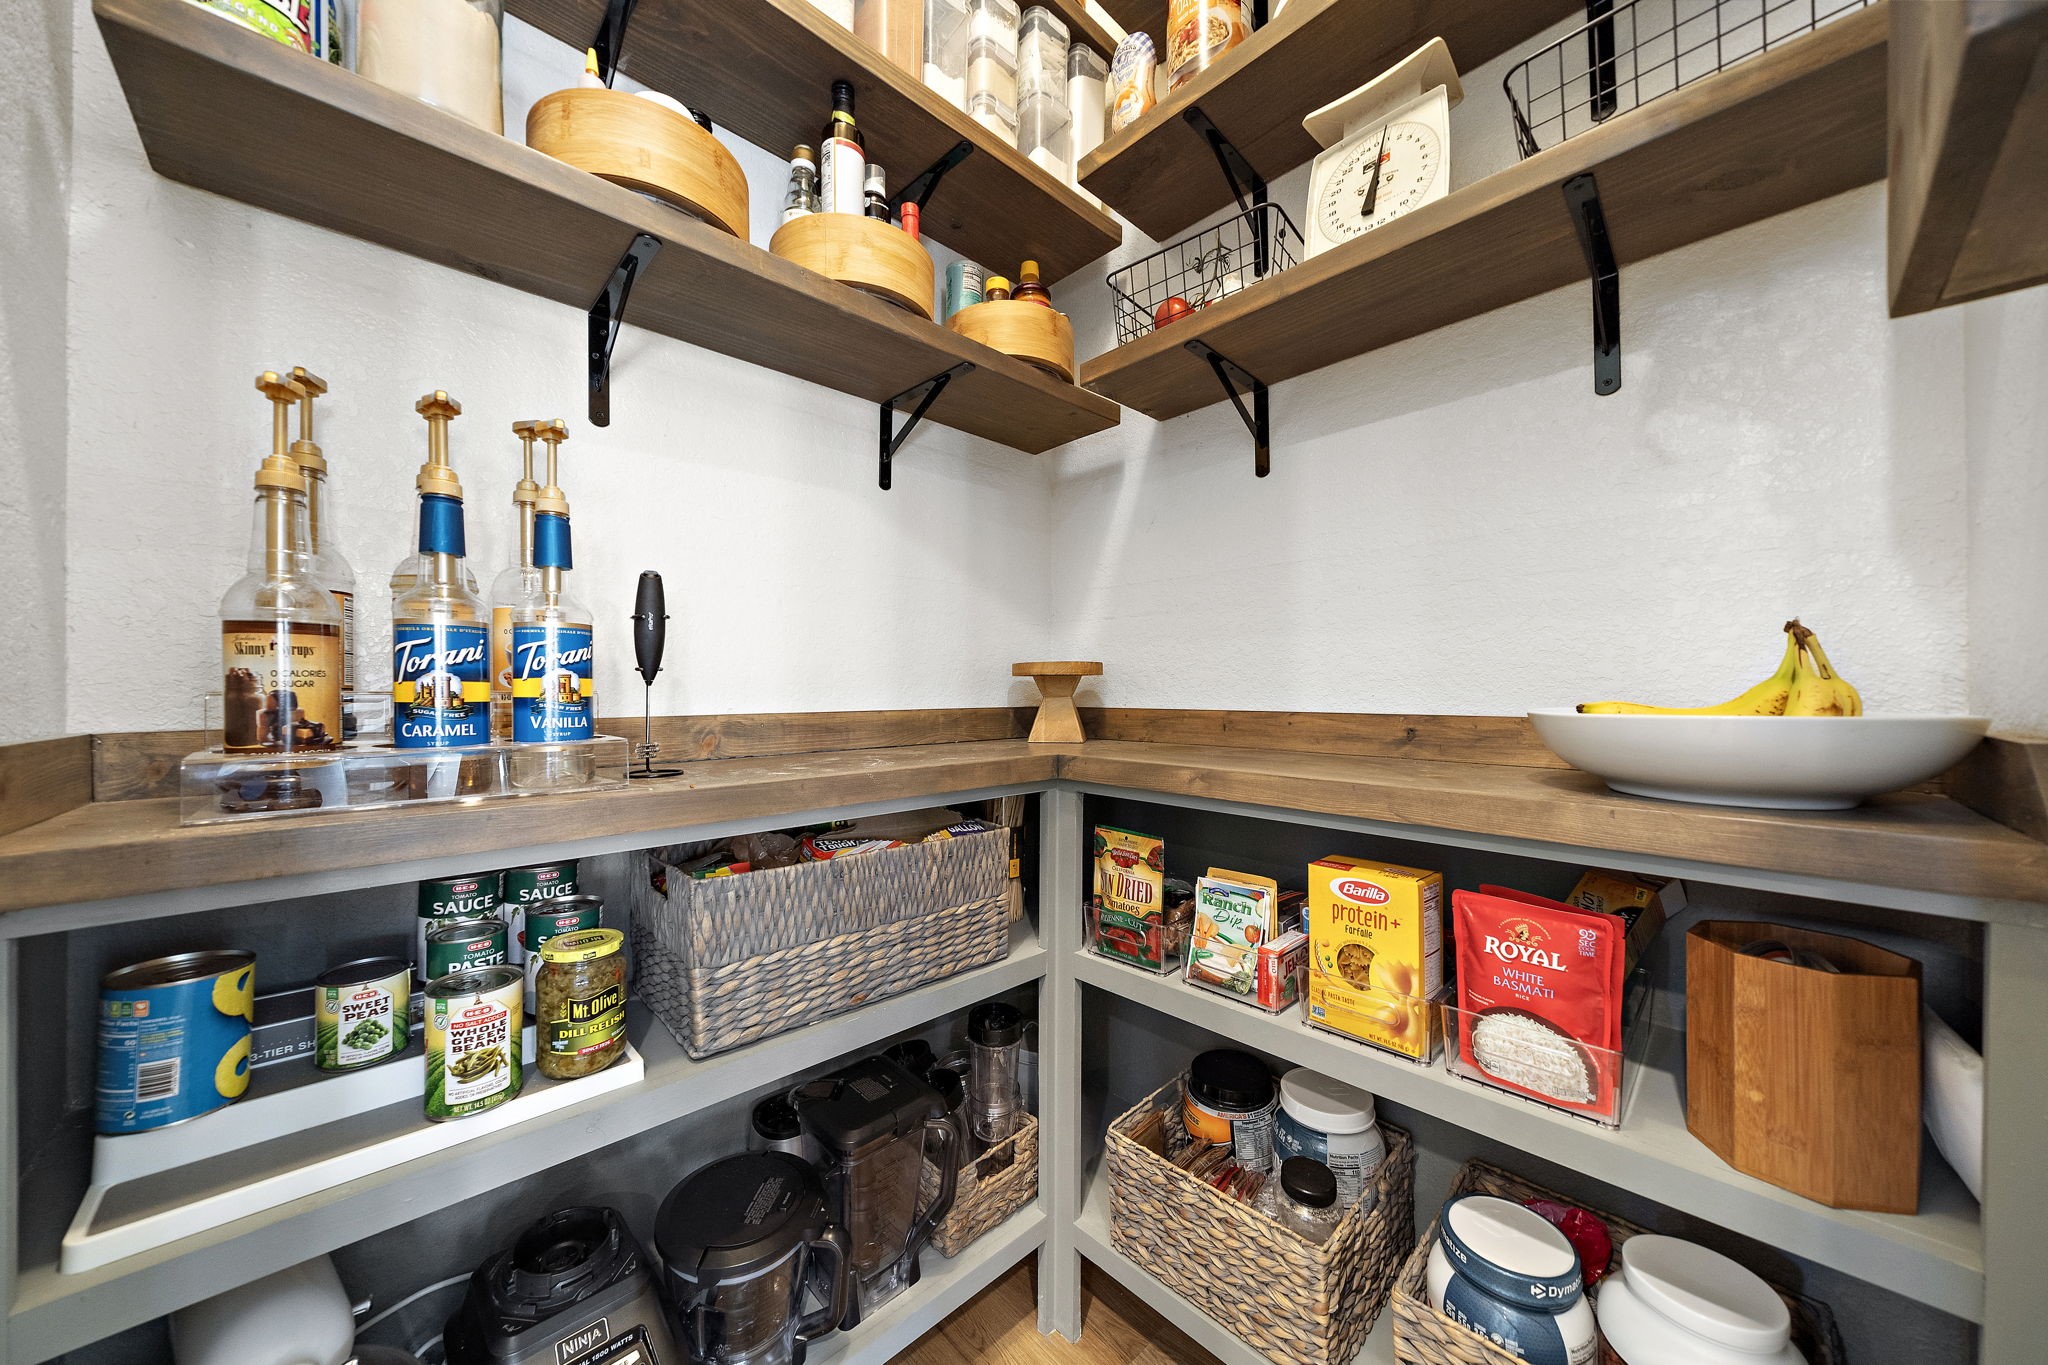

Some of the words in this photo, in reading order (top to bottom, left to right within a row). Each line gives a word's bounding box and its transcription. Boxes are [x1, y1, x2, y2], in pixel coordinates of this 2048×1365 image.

[234, 641, 267, 658] Skinny
[395, 637, 485, 685] Torani
[518, 640, 593, 682] Torani
[283, 669, 327, 678] CALORIES
[282, 680, 315, 688] SUGAR
[443, 710, 466, 718] FREE
[530, 716, 588, 729] VANILLA
[402, 723, 477, 737] CARAMEL
[947, 823, 985, 833] GALLON
[819, 840, 856, 851] TOUGH
[519, 882, 573, 901] SAUCE
[536, 879, 559, 887] TOMATO
[1116, 872, 1153, 904] DRIED
[1343, 883, 1386, 901] Barilla
[433, 894, 494, 915] SAUCE
[451, 892, 477, 900] TOMATO
[1202, 893, 1252, 916] Ranch
[1213, 908, 1243, 928] Dip
[1332, 903, 1388, 931] protein
[554, 926, 579, 934] TOMATO
[1578, 939, 1596, 947] SEC
[448, 951, 504, 974] PASTE
[464, 948, 495, 960] TOMATO
[1484, 935, 1567, 972] ROYAL
[1502, 966, 1544, 986] WHITE
[1494, 975, 1554, 999] BASMATI
[342, 996, 390, 1013] SWEET
[573, 1003, 591, 1019] Mt.
[591, 992, 618, 1015] Olive
[1515, 993, 1530, 1001] RICE
[344, 1005, 389, 1022] PEAS
[466, 1019, 481, 1027] SALT
[483, 1012, 505, 1023] ADDED
[451, 1018, 507, 1038] WHOLE
[559, 1028, 587, 1039] DILL
[589, 1010, 625, 1034] RELISH
[451, 1026, 507, 1046] GREEN
[452, 1034, 507, 1053] BEANS
[582, 1044, 600, 1053] SINCE
[1217, 1111, 1247, 1120] AMERICA'S
[562, 1328, 602, 1359] NINJA
[592, 1347, 609, 1361] 1500
[610, 1334, 634, 1351] WATTS
